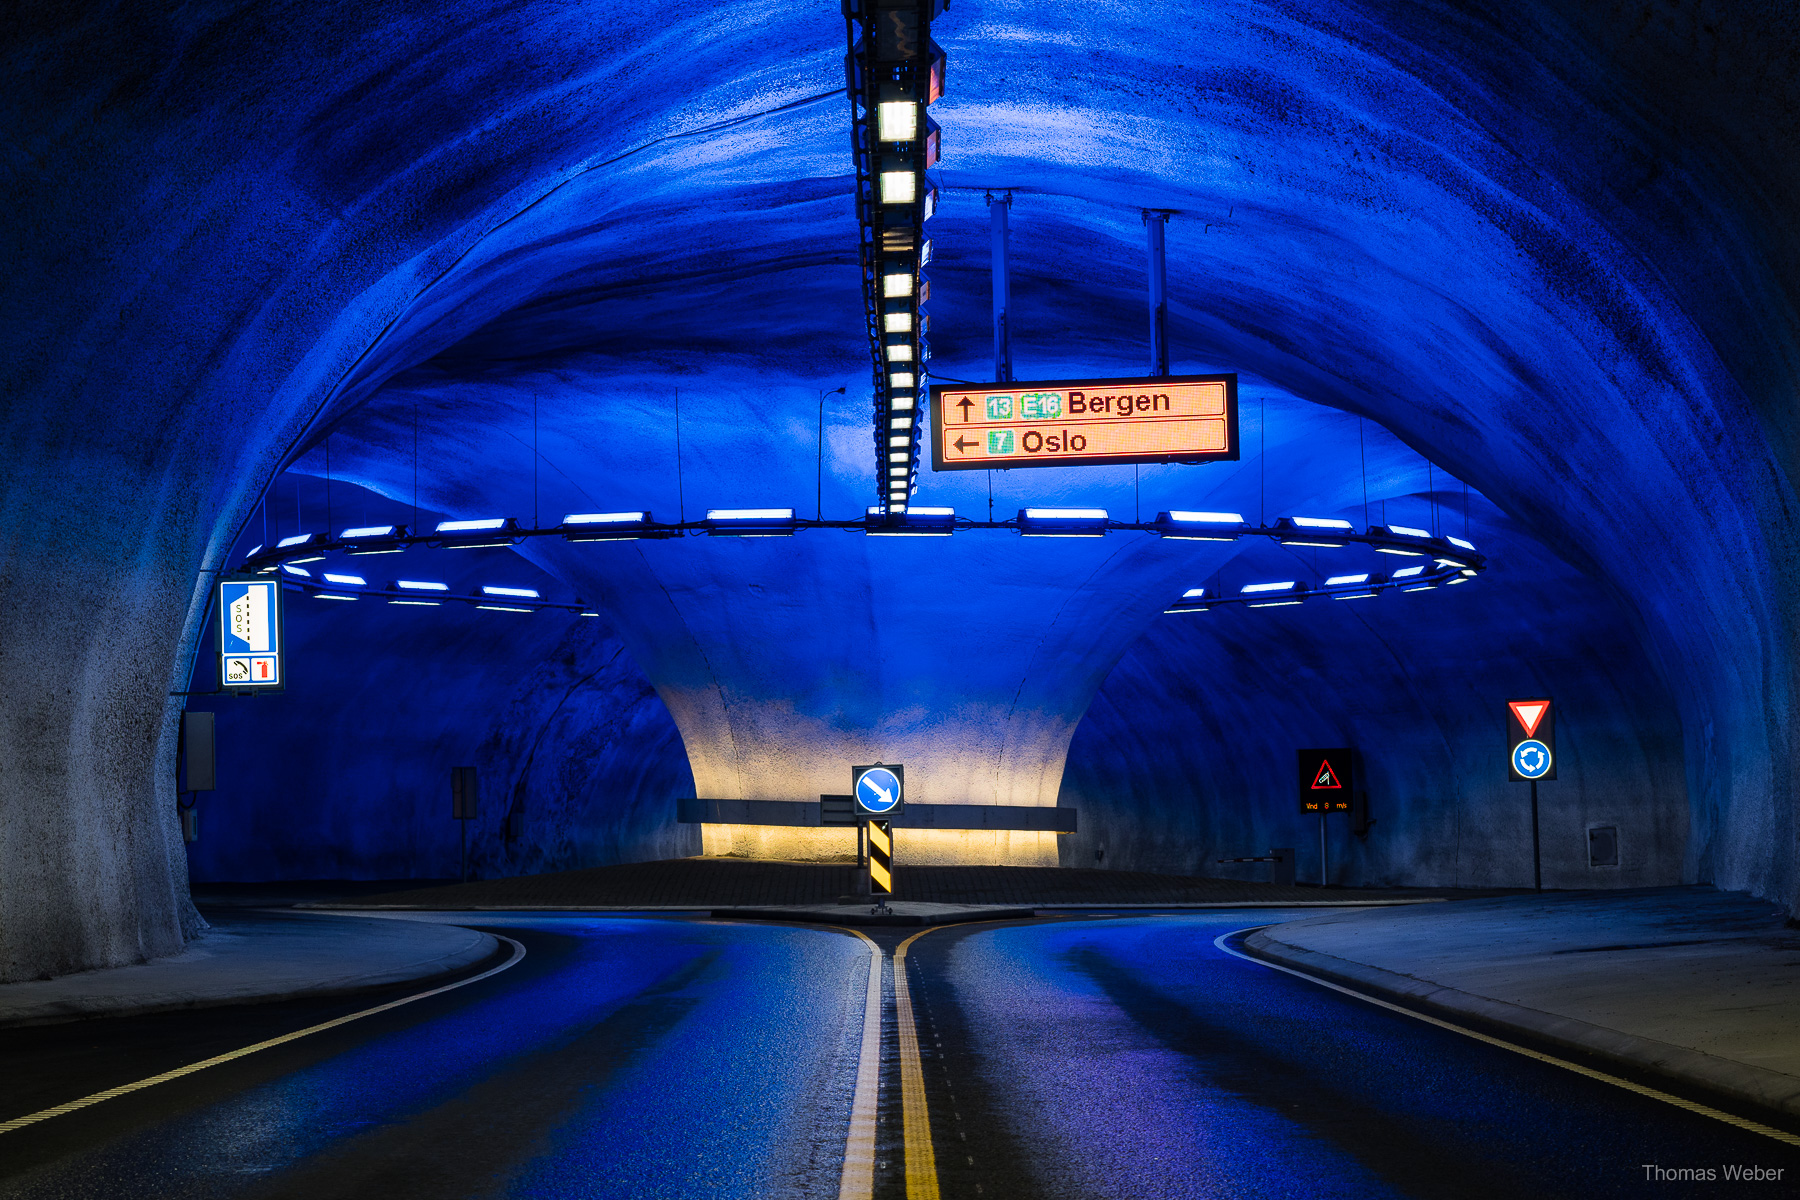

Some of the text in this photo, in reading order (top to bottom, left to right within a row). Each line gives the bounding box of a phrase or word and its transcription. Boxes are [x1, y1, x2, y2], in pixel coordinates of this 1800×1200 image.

[988, 391, 1170, 417] 13 E16 Bergen
[995, 430, 1087, 453] 7 Oslo
[235, 604, 243, 633] SOS
[228, 672, 243, 680] SOS
